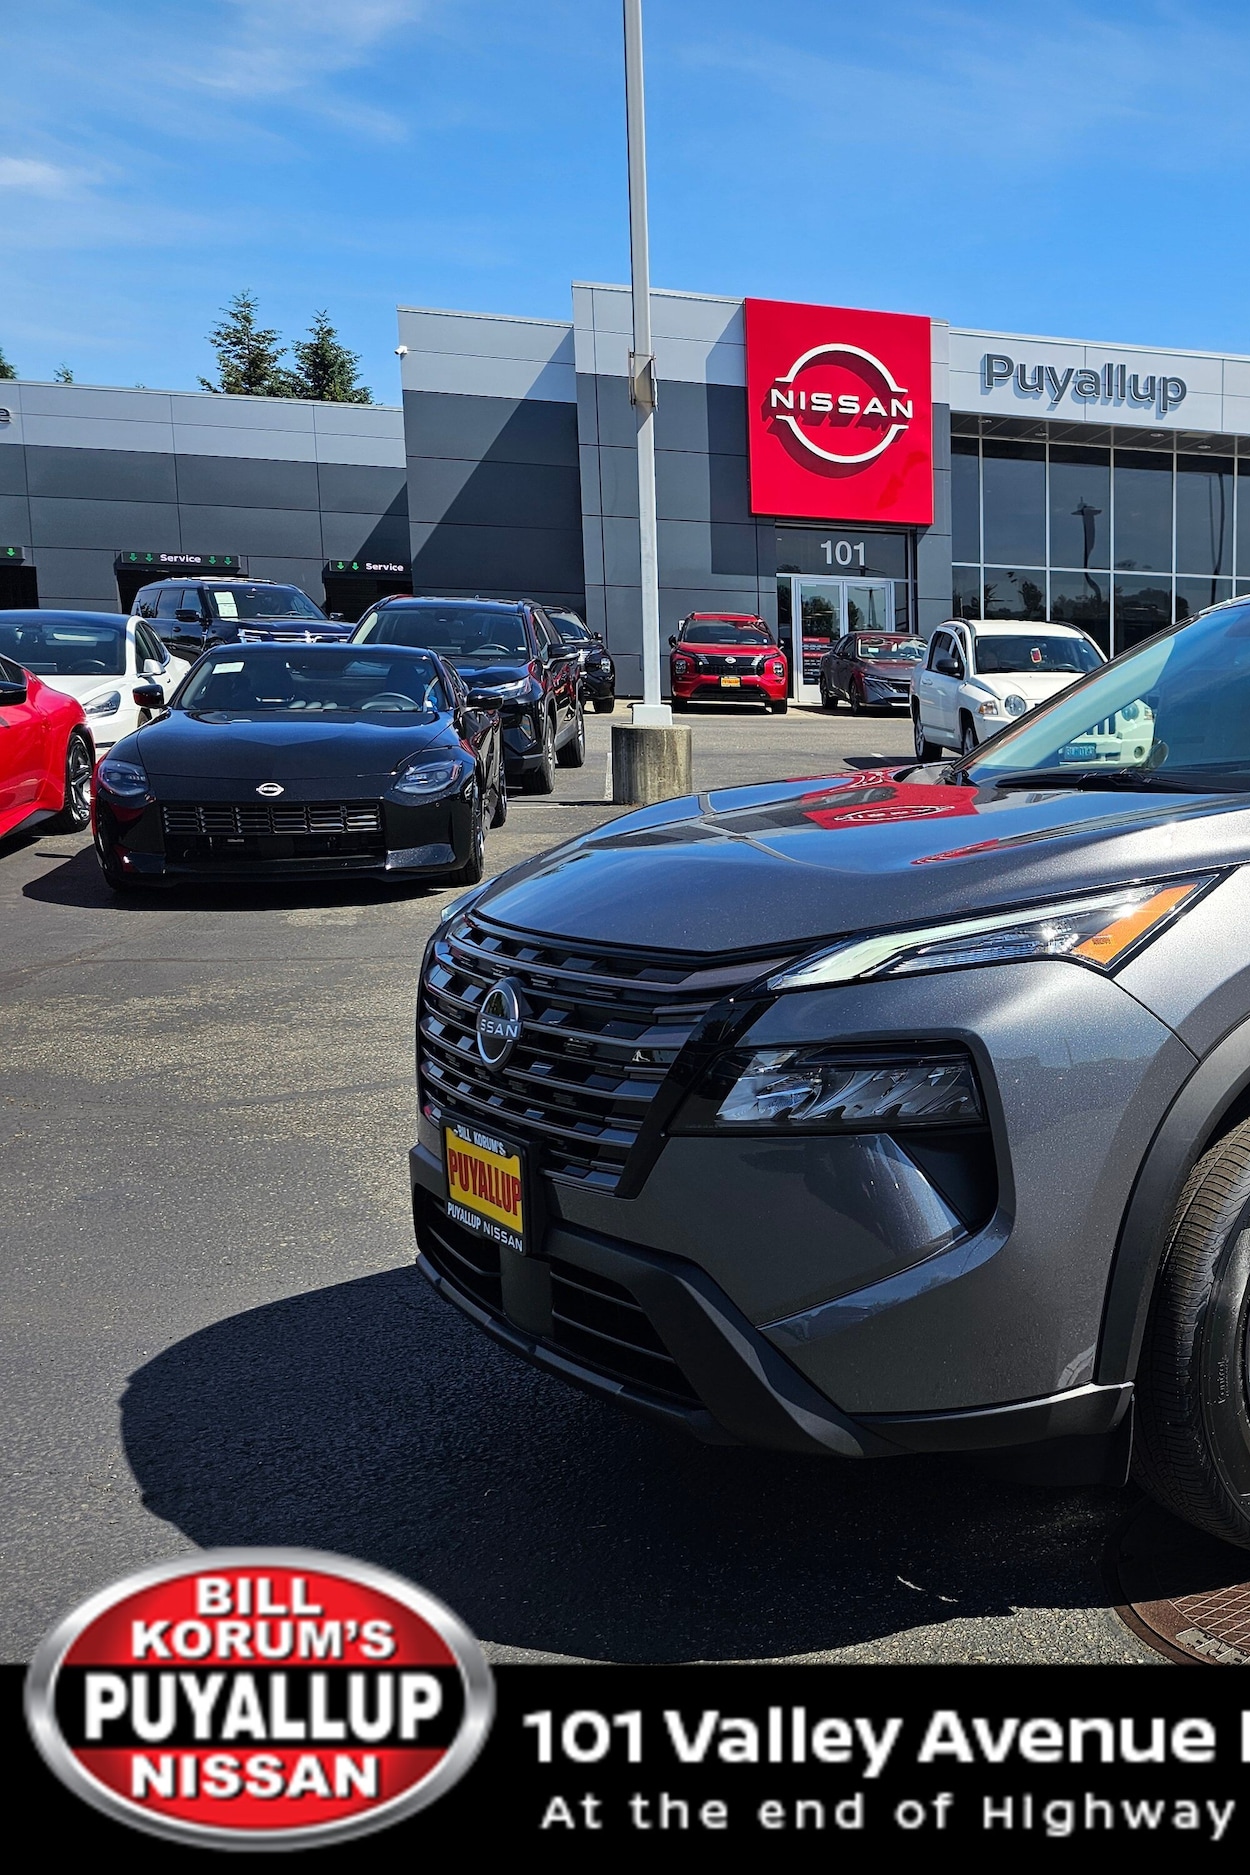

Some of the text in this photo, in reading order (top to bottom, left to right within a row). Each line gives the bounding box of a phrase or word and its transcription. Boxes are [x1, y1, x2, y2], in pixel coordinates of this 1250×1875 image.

[984, 353, 1188, 413] Puyallup
[771, 388, 913, 419] NISSAN
[159, 553, 202, 564] Service
[365, 562, 404, 572] Service
[820, 540, 866, 567] 101
[480, 1018, 518, 1038] SSAN
[457, 1124, 472, 1142] BILL
[448, 1147, 521, 1217] PUYALLUP
[447, 1201, 523, 1253] PUYALLUP NISSAN
